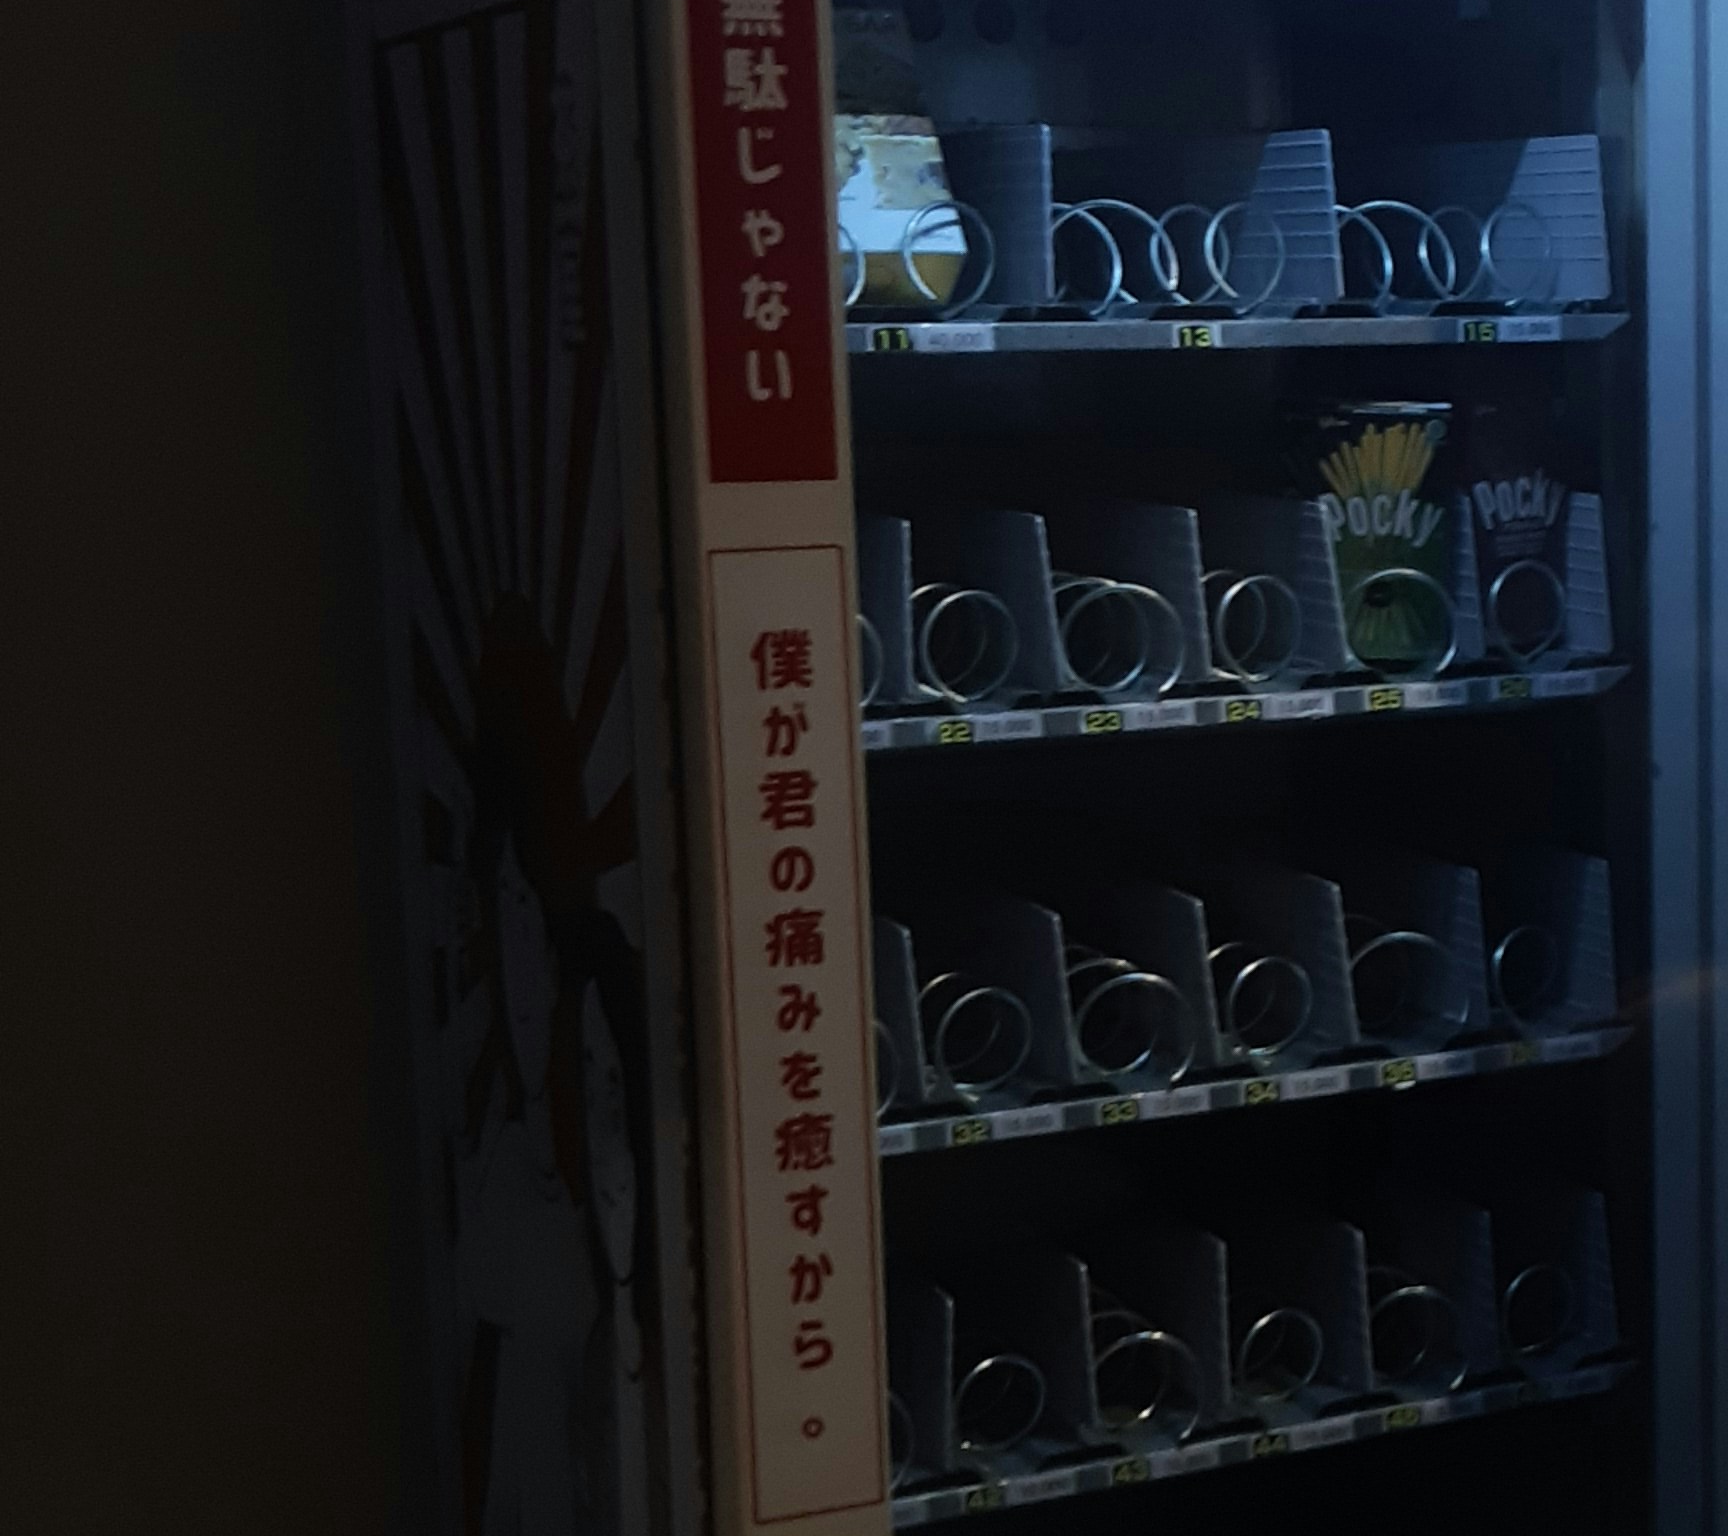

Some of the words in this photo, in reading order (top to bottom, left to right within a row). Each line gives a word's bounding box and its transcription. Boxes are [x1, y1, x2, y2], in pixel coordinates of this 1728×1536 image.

[877, 328, 909, 351] 11
[1179, 327, 1212, 348] 13
[750, 628, 834, 1438] 僕が君の痛みを癒すから。
